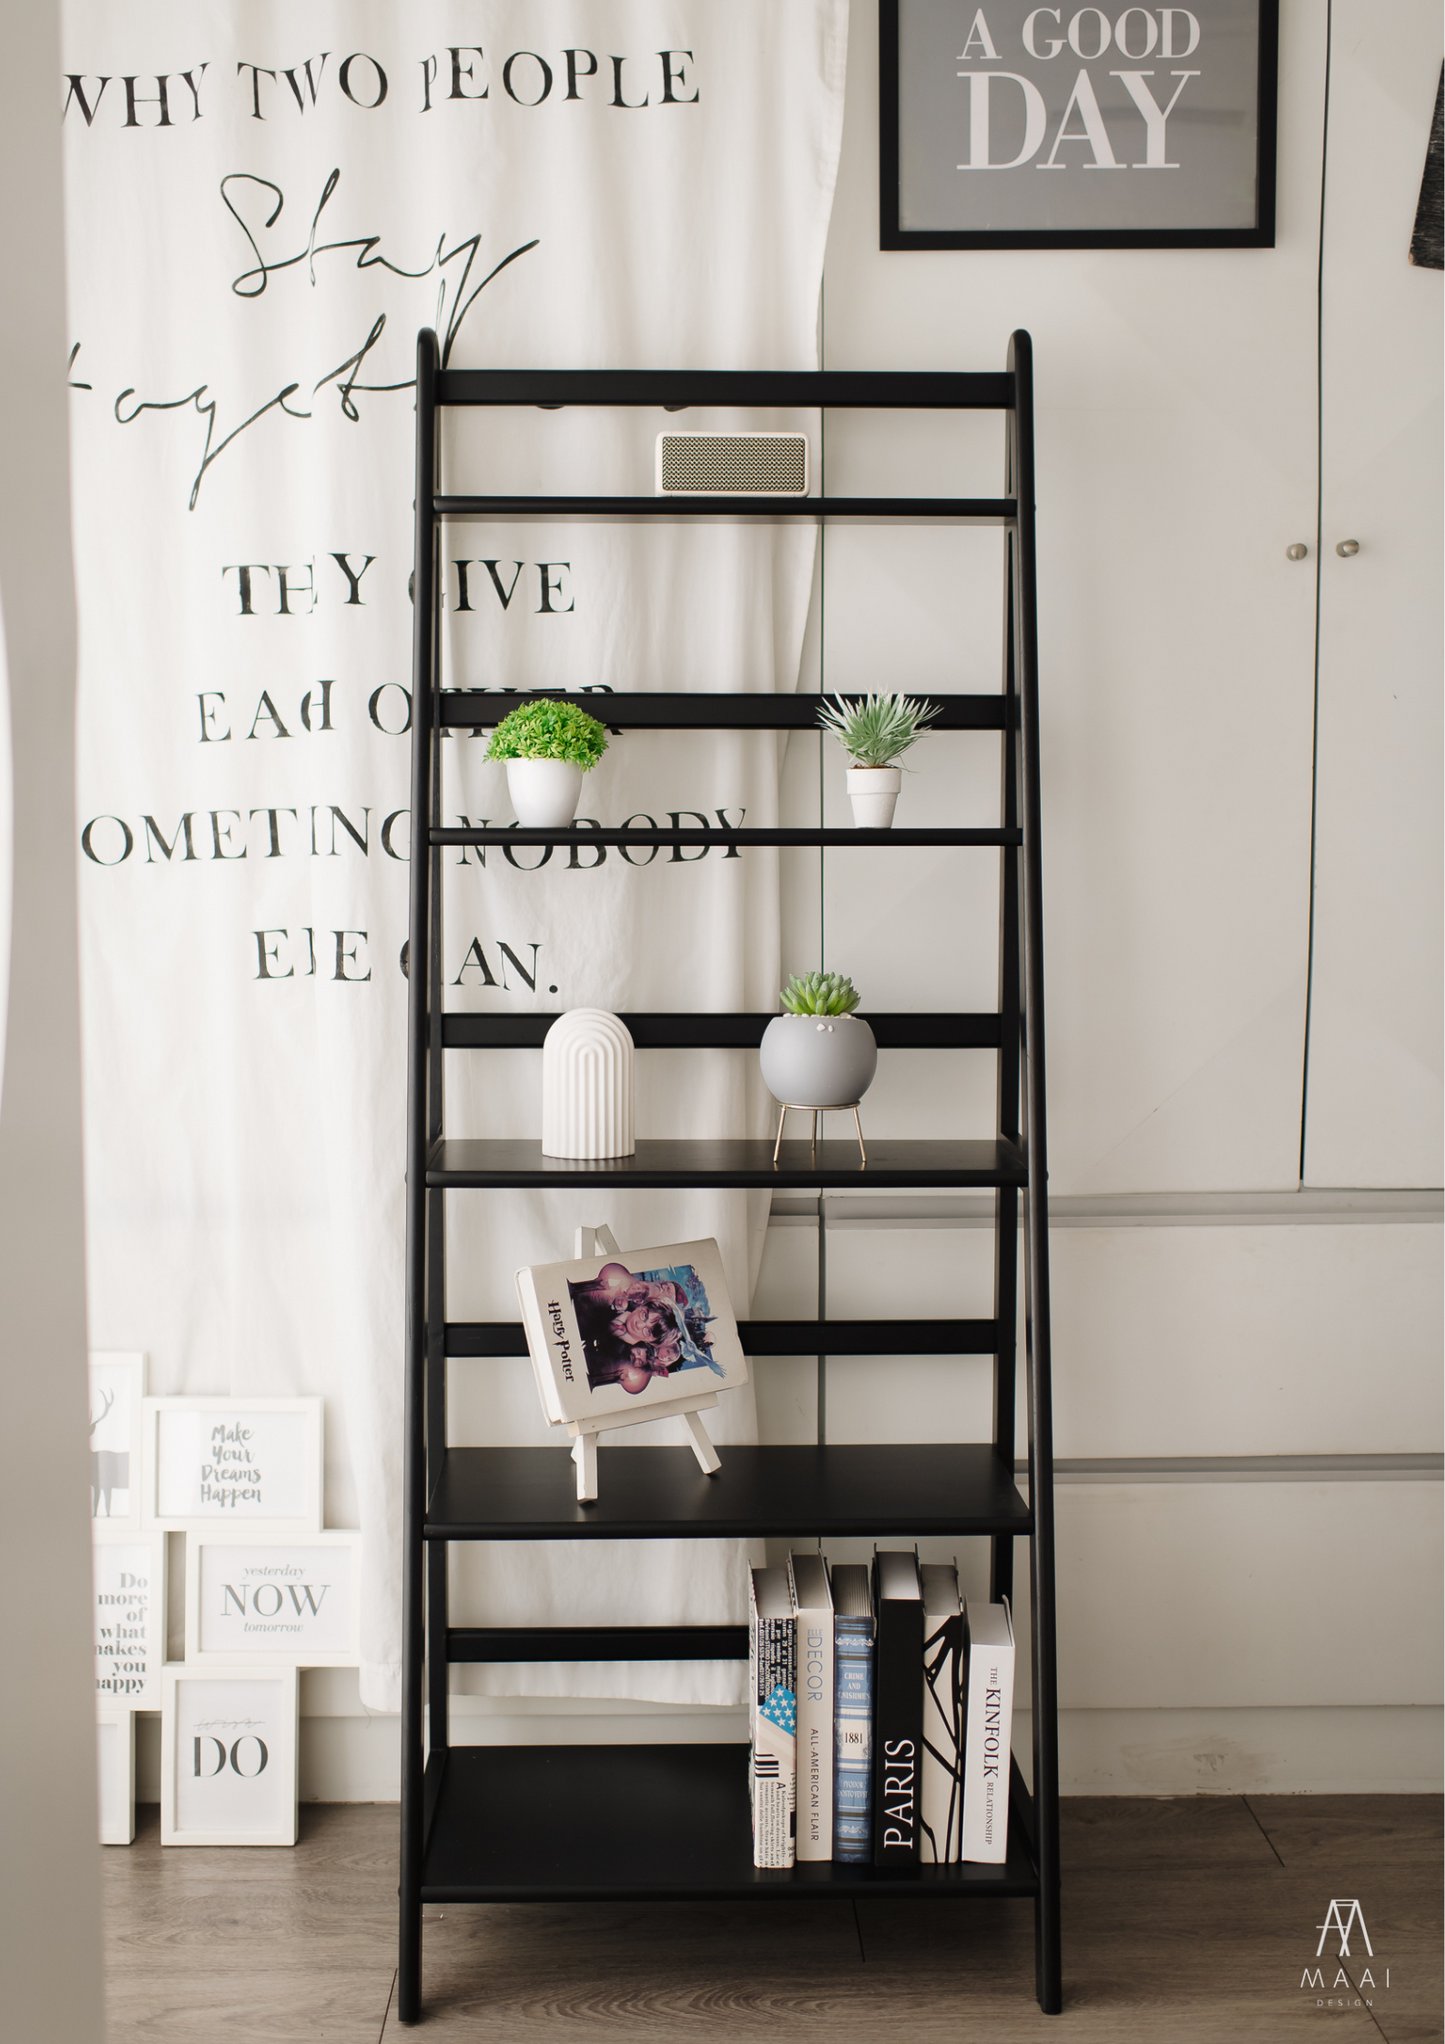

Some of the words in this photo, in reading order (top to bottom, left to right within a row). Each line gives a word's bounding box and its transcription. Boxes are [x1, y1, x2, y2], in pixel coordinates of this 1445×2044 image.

[955, 7, 1003, 60] A
[1021, 7, 1201, 60] GOOD
[236, 52, 389, 121] TWO
[417, 46, 700, 114] PEOPLE
[955, 68, 1201, 170] DAY
[219, 168, 540, 369] Stay
[455, 807, 747, 871] NOBODY
[547, 1299, 566, 1340] Harry
[552, 1339, 575, 1383] Potter
[211, 1421, 255, 1448] Make
[212, 1445, 256, 1466] Your
[201, 1464, 262, 1485] Dreams
[200, 1483, 262, 1508] Happen
[119, 1572, 149, 1589] Do
[242, 1563, 306, 1581] yesterday
[97, 1594, 149, 1606] more
[126, 1606, 149, 1622] of
[220, 1583, 331, 1617] NOW
[99, 1622, 148, 1640] what
[243, 1621, 304, 1633] tomorrow
[112, 1661, 147, 1677] you
[806, 1636, 823, 1702] DECOR
[843, 1671, 865, 1681] CRIME
[989, 1666, 998, 1686] THE
[846, 1682, 861, 1690] AND
[844, 1731, 864, 1744] 1881
[983, 1687, 1001, 1779] KINFOLK
[191, 1735, 269, 1778] DO
[810, 1728, 820, 1808] ALL-AMERICAN
[883, 1738, 915, 1849] PARIS
[810, 1812, 820, 1841] FLAIR
[984, 1781, 994, 1846] RELATIONSHIP
